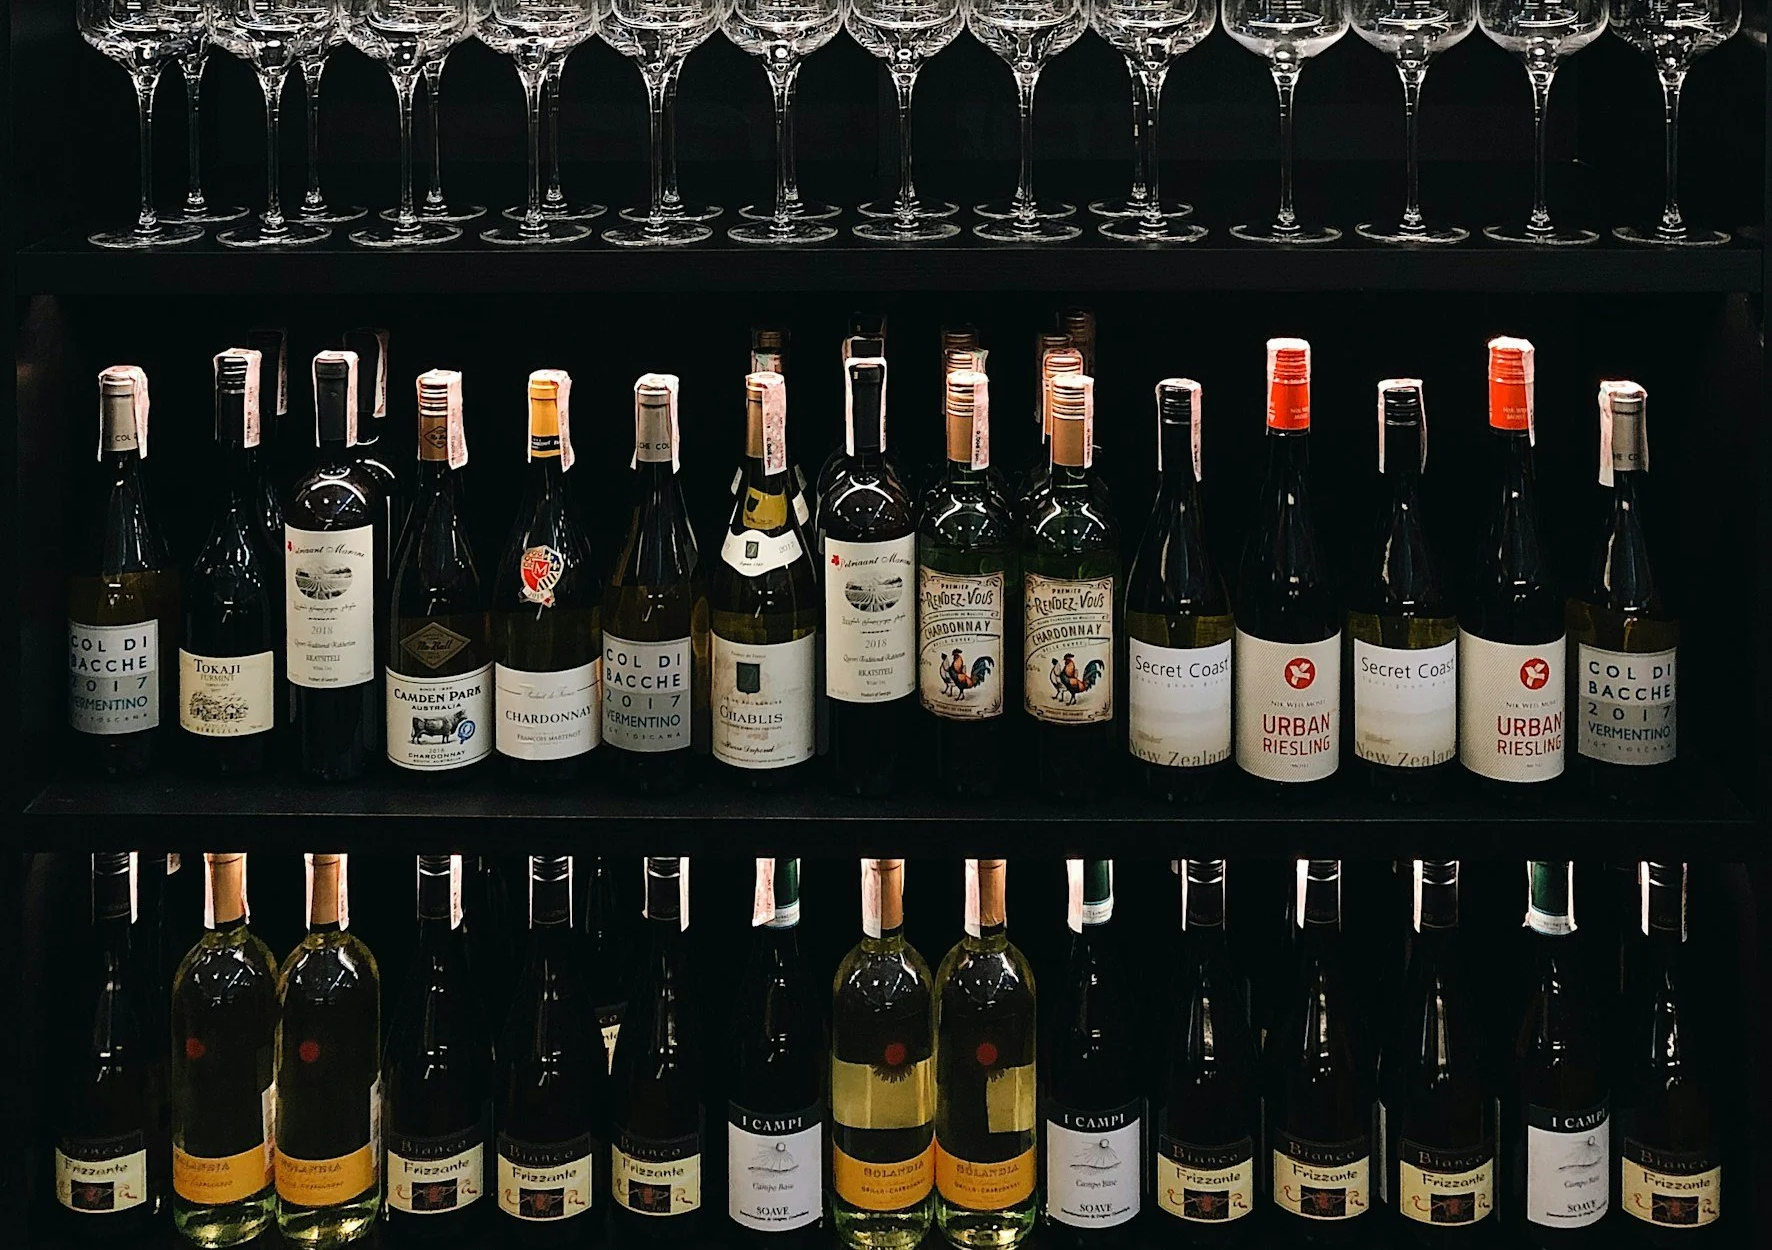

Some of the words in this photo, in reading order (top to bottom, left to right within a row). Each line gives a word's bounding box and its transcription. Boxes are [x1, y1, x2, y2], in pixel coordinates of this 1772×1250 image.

[533, 561, 548, 577] M
[925, 588, 994, 611] RENDEZ-VOUS
[1035, 591, 1104, 615] RENDEZ-VOUS
[924, 620, 991, 640] CHARDONNAY
[1032, 623, 1102, 646] CHARDONNAY
[71, 635, 106, 652] COL
[124, 635, 147, 651] DI
[865, 639, 887, 648] 2018
[193, 658, 240, 674] TOKAJI
[606, 649, 642, 668] COL
[658, 653, 681, 668] DI
[1136, 655, 1182, 678] Secret
[1189, 657, 1229, 678] Coast
[1361, 657, 1412, 679] Secret
[1418, 656, 1454, 679] Coast
[606, 668, 681, 689] BACCHE
[1589, 661, 1637, 680] COL
[1653, 663, 1671, 680] DI
[394, 688, 445, 703] CAMDEN
[449, 685, 481, 701] PARK
[606, 691, 681, 707] 2017
[1589, 681, 1671, 701] BACCHE
[411, 703, 461, 711] AUSTRALIA
[506, 705, 591, 724] CHARDONNAY
[719, 705, 783, 724] CHABLIS
[1589, 702, 1671, 722] 2017
[606, 710, 681, 727] VERMENTINO
[1263, 712, 1330, 736] URBAN
[1497, 711, 1562, 737] URBAN
[1588, 721, 1671, 741] VERMENTINO
[408, 750, 465, 759] CHARDONNAY
[1263, 735, 1330, 756] RIESLING
[1497, 735, 1561, 756] RIESLING
[752, 1116, 802, 1132] CAMPI
[1075, 1113, 1125, 1129] CAMPI
[1564, 1108, 1605, 1129] CAMPI
[508, 1143, 573, 1161] Bianco
[1173, 1144, 1239, 1164] Bianco
[1289, 1141, 1354, 1161] Bianco
[403, 1158, 470, 1176] Frizzante
[512, 1166, 577, 1181] Frizzante
[621, 1157, 684, 1177] Frizzante
[1176, 1167, 1242, 1185] Frizzante
[1292, 1163, 1358, 1180] Frizzante
[1422, 1173, 1486, 1188] Frizzante
[1643, 1172, 1711, 1190] Frizzante
[756, 1206, 789, 1216] SOAVE
[1079, 1203, 1113, 1213] SOAVE
